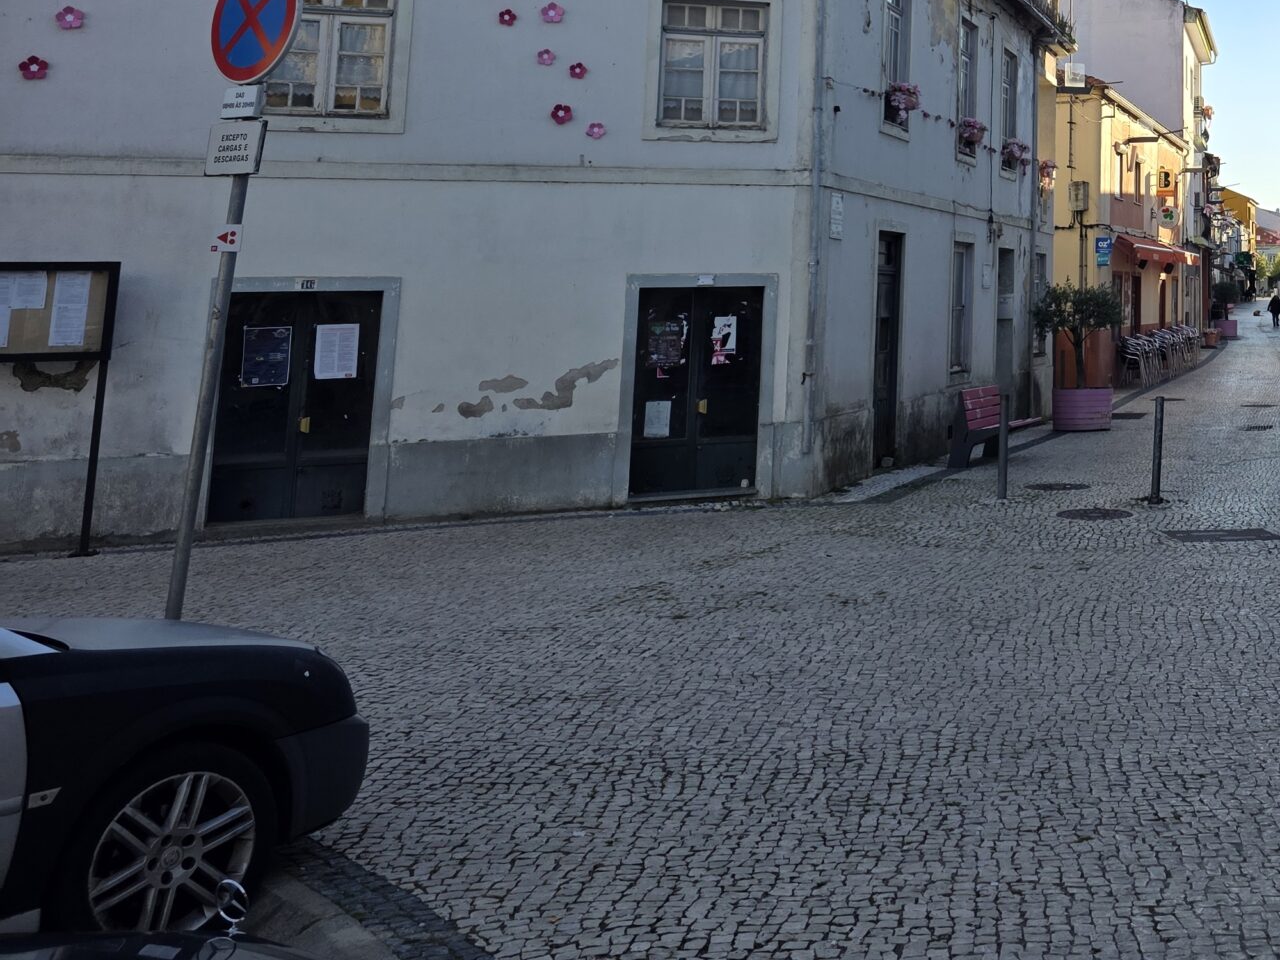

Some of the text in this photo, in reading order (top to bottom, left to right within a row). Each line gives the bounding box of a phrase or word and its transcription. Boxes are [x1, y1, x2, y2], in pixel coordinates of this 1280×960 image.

[221, 133, 248, 142] EXCEPTO
[217, 143, 249, 153] CARGAS E
[213, 154, 249, 164] DESCARGAS
